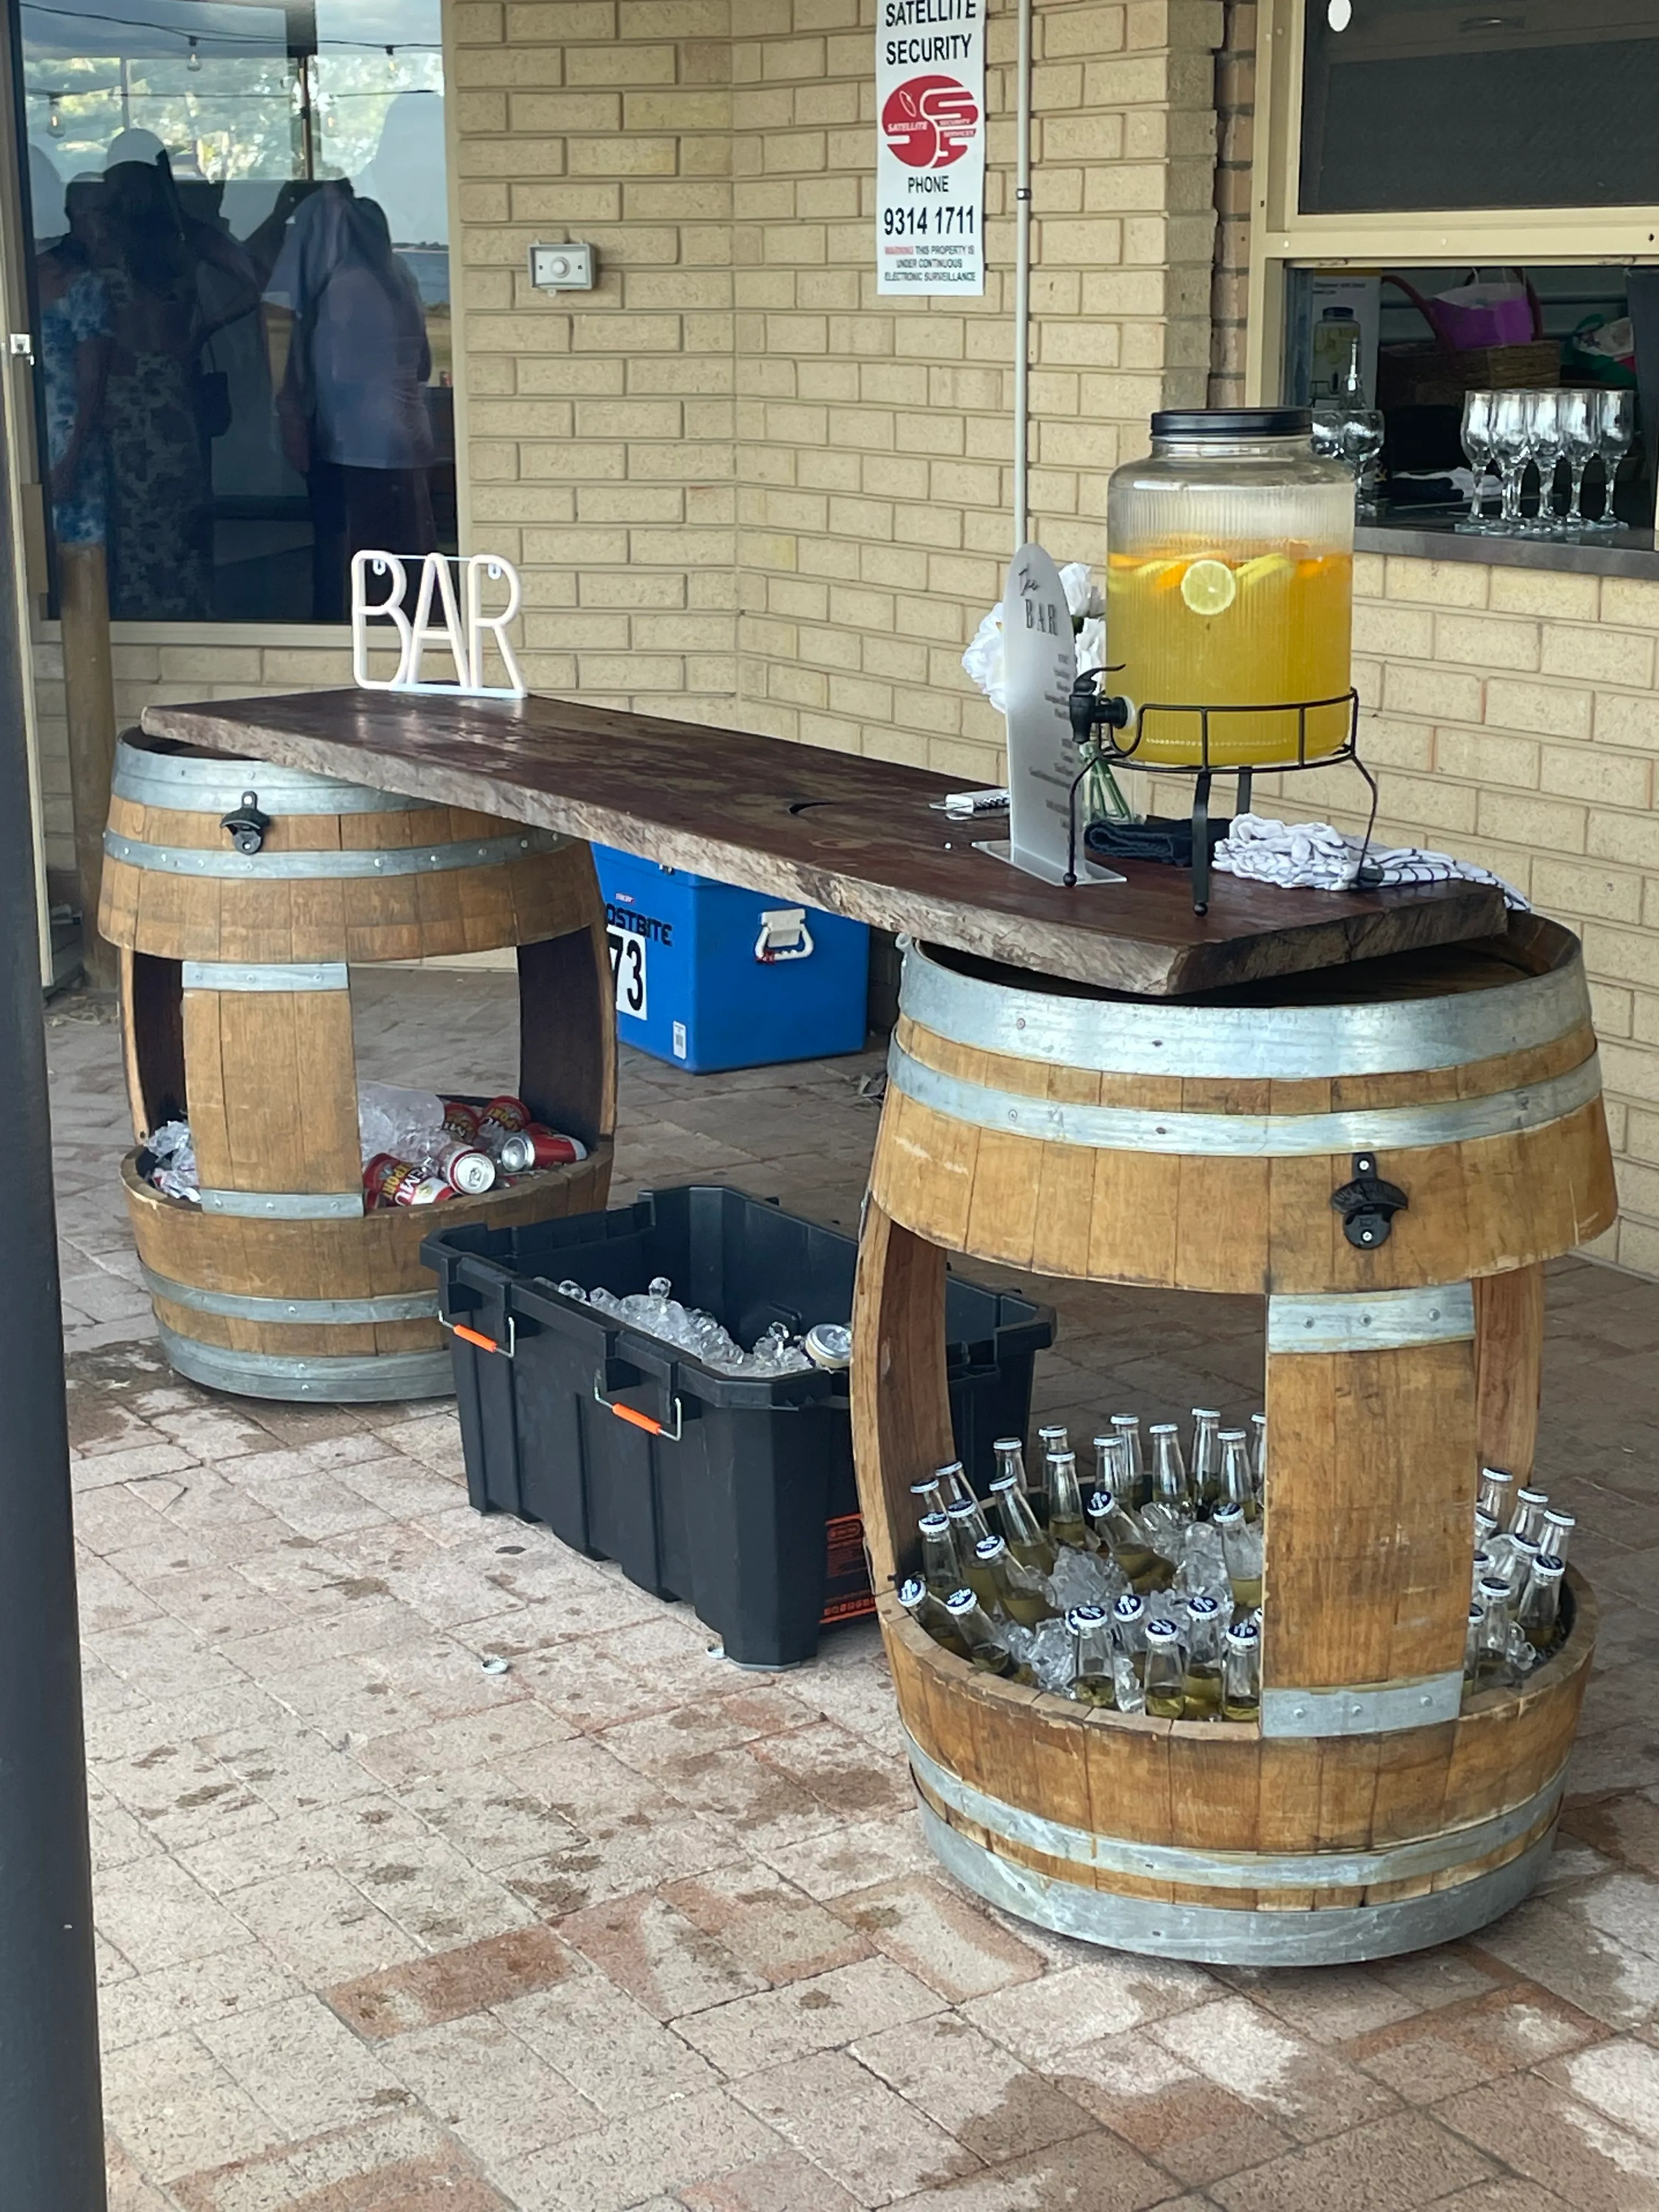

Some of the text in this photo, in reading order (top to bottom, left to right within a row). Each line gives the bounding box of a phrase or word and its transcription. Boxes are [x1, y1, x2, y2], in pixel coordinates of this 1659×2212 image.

[885, 0, 976, 27] SATELLITE
[886, 33, 972, 65] SECURITY
[888, 121, 928, 132] SATELLITE
[908, 176, 949, 193] PHONE
[884, 205, 974, 235] 9314 1711
[896, 258, 963, 268] UNDER CONTINUOUS
[931, 245, 966, 255] PROPERTY
[924, 272, 975, 281] SURVEILLANCE
[352, 550, 527, 698] BAR
[1025, 599, 1058, 635] BAR
[608, 934, 643, 1011] 73
